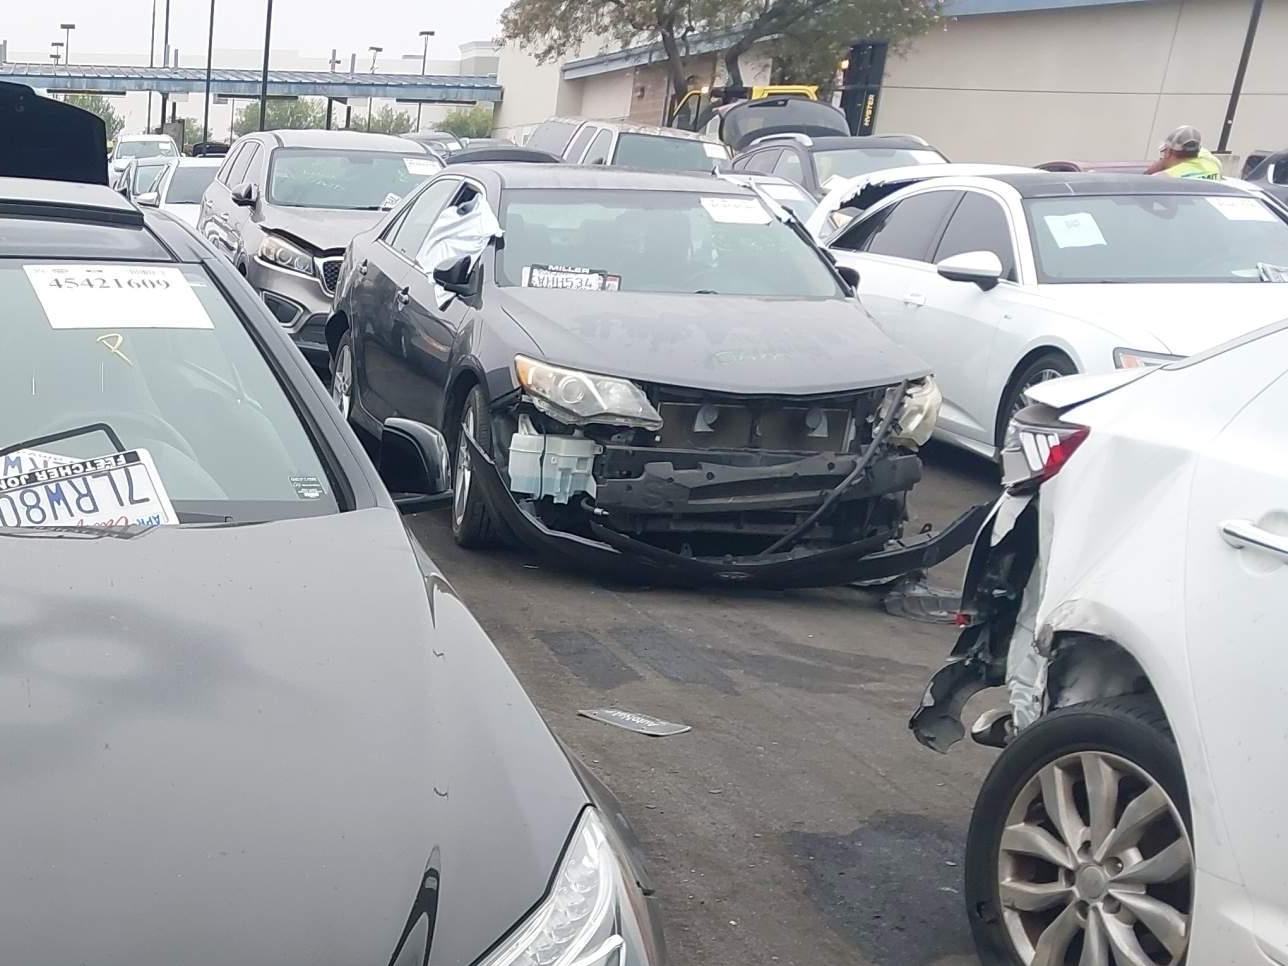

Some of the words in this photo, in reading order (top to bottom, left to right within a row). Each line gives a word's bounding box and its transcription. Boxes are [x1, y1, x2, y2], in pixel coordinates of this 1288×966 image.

[864, 94, 875, 126] HYSTER
[548, 264, 590, 274] MILLER
[48, 276, 171, 290] 45421609
[34, 454, 126, 486] FLETCHER
